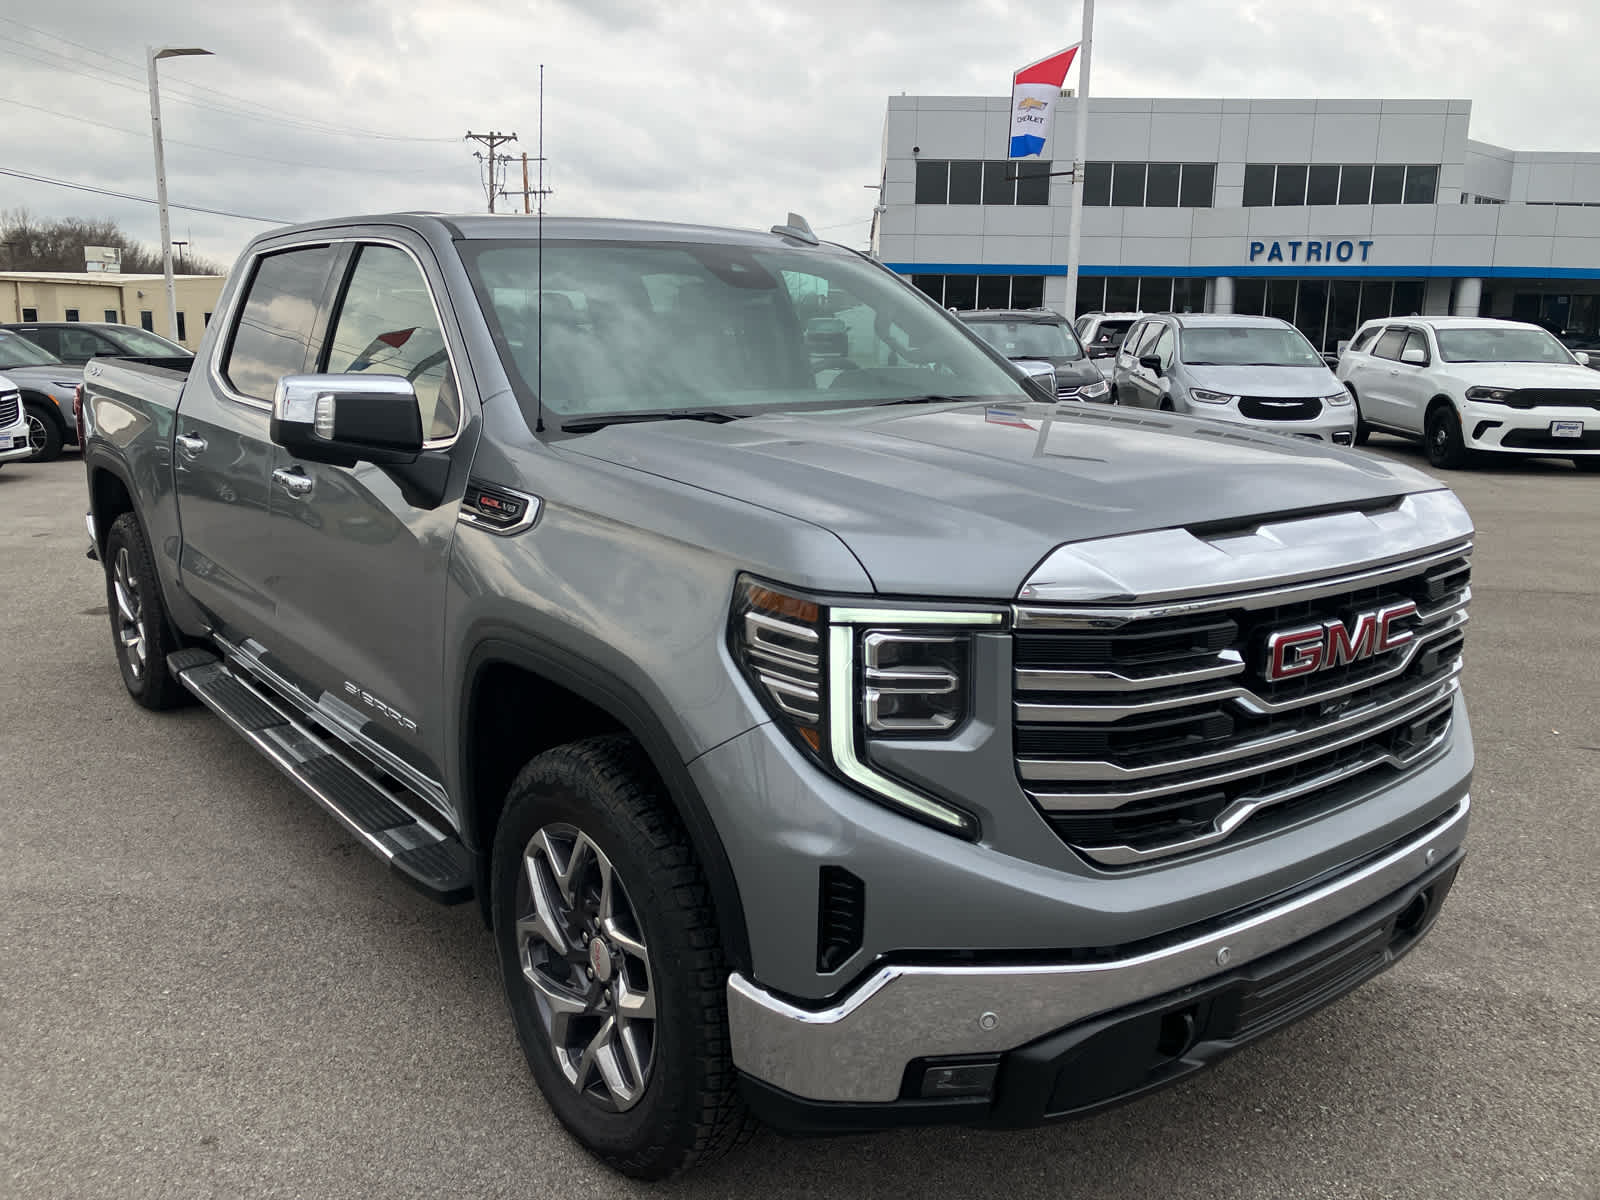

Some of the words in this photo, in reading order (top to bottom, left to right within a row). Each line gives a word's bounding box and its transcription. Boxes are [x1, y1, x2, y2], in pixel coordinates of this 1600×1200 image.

[1249, 240, 1374, 262] PATRIOT
[1265, 600, 1417, 683] GMC
[344, 680, 417, 733] SIERRA
